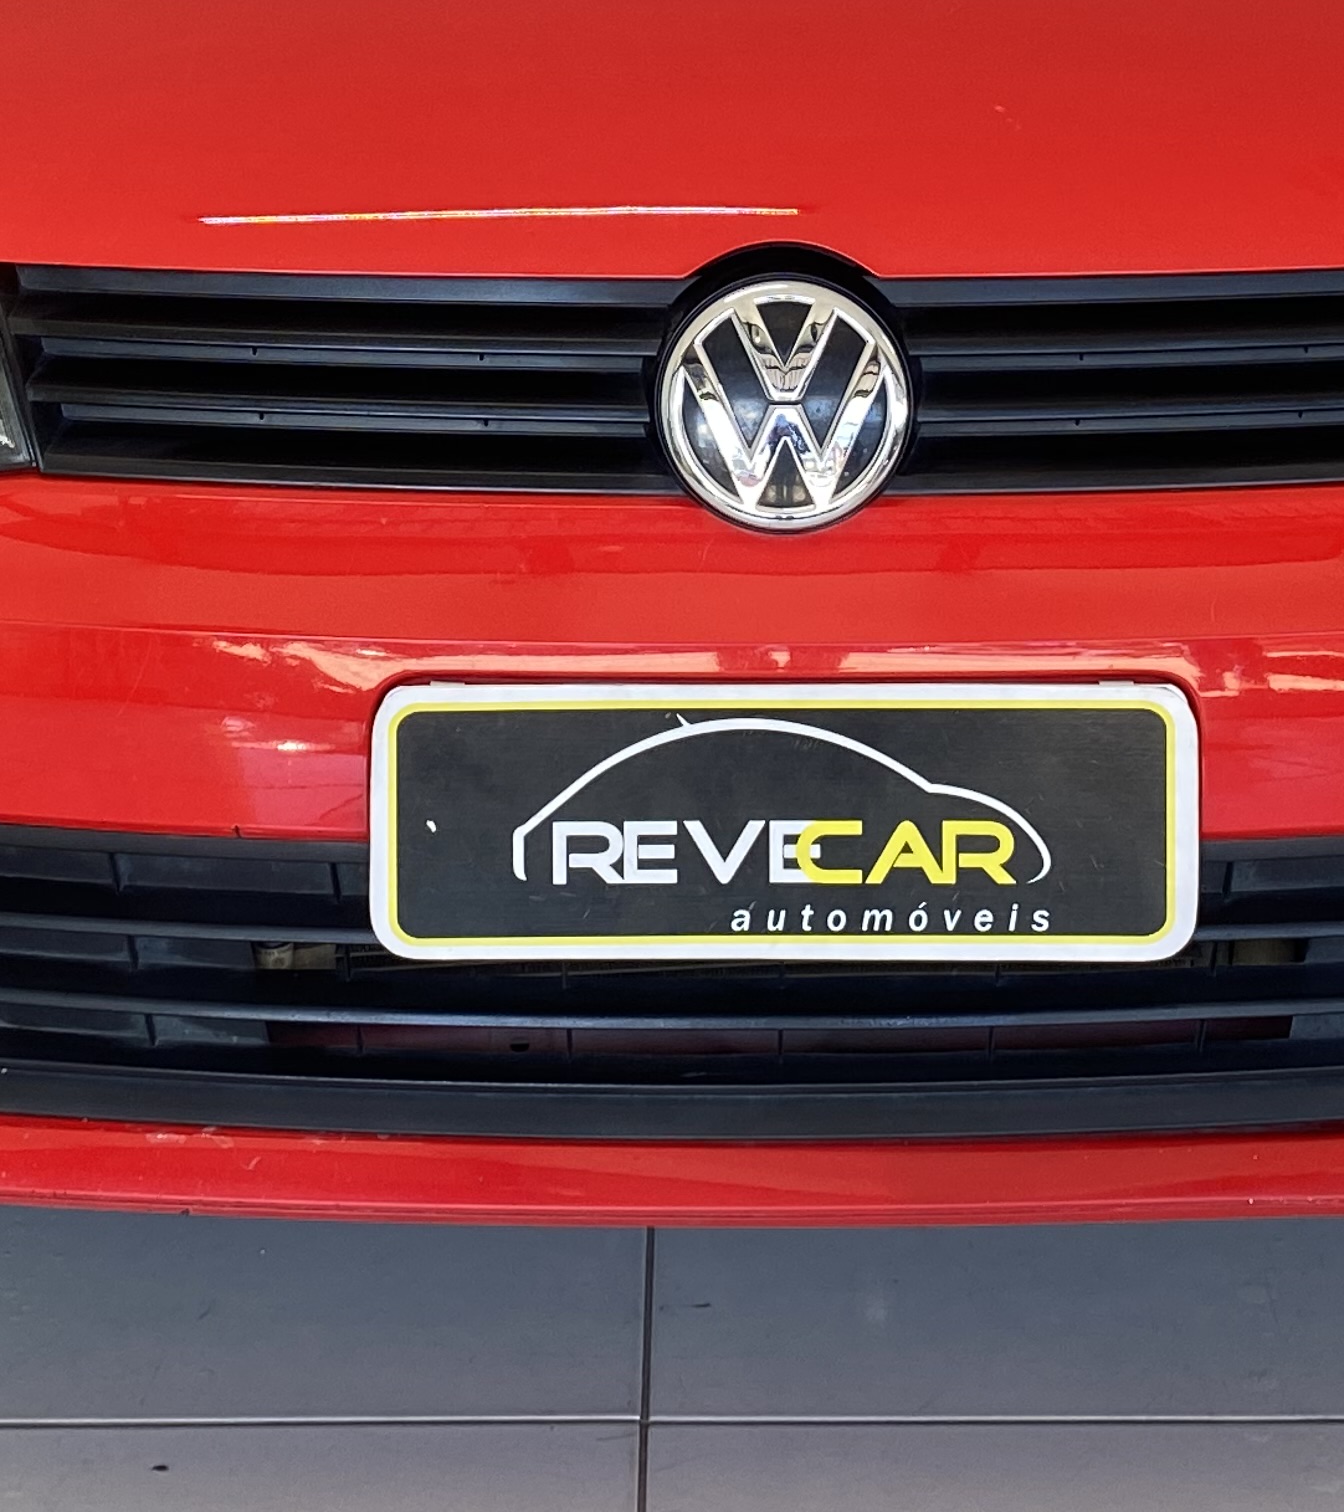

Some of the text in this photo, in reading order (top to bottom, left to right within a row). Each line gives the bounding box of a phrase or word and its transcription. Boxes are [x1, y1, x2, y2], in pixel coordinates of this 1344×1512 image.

[670, 293, 897, 514] VW
[552, 820, 1016, 885] REVECAR
[730, 900, 1051, 933] automóveis
